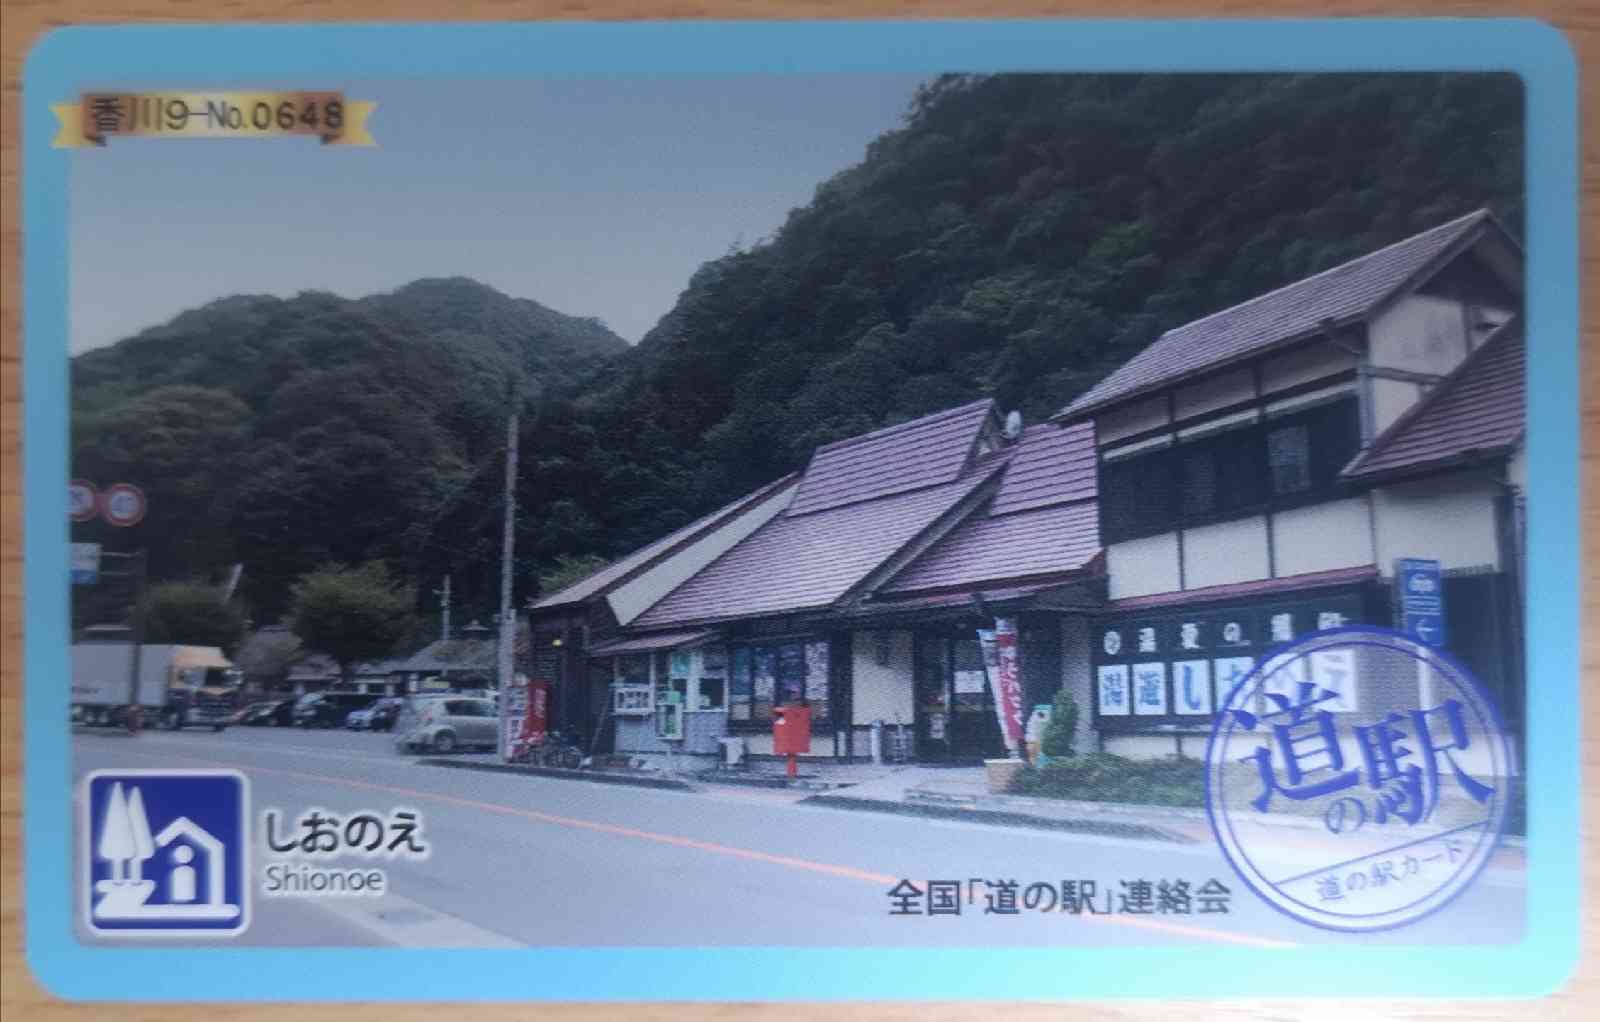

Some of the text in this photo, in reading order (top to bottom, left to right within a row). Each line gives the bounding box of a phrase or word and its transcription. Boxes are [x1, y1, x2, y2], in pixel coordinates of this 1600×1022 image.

[1226, 682, 1498, 835] 道の駅
[267, 812, 425, 853] しおのえ
[267, 866, 384, 891] Shionoe
[1315, 838, 1463, 902] 道の駅カード
[887, 878, 1232, 916] 全国「道の駅」連絡会
